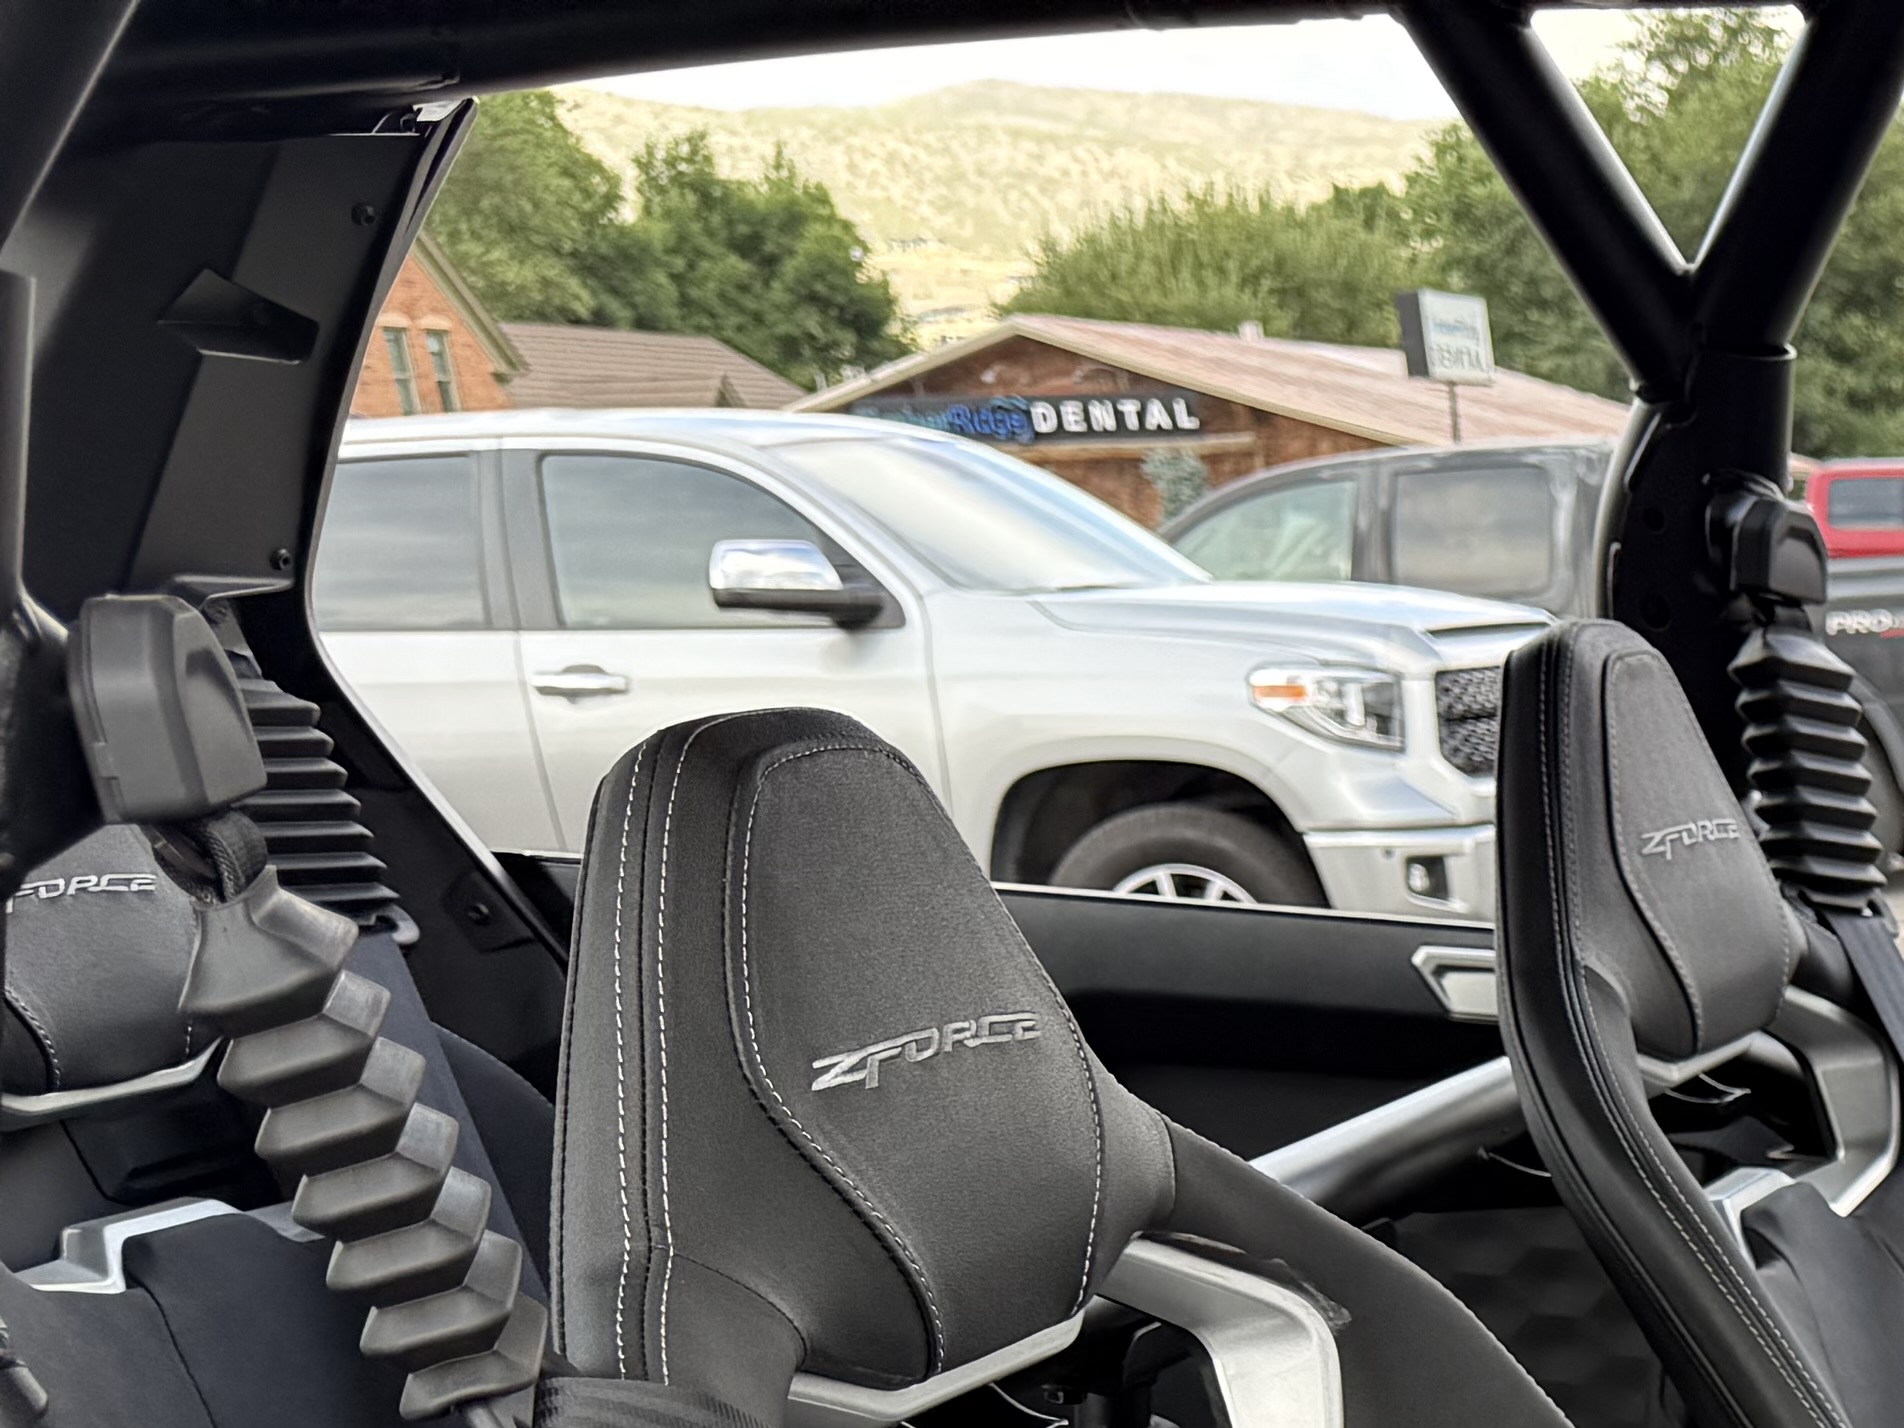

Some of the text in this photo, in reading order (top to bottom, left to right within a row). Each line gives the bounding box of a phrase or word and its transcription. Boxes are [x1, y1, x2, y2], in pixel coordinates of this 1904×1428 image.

[1030, 398, 1200, 433] DENTAL
[1641, 818, 1740, 860] ZFORCE
[5, 873, 157, 914] FORCE
[811, 1010, 1041, 1091] ZFORCE
